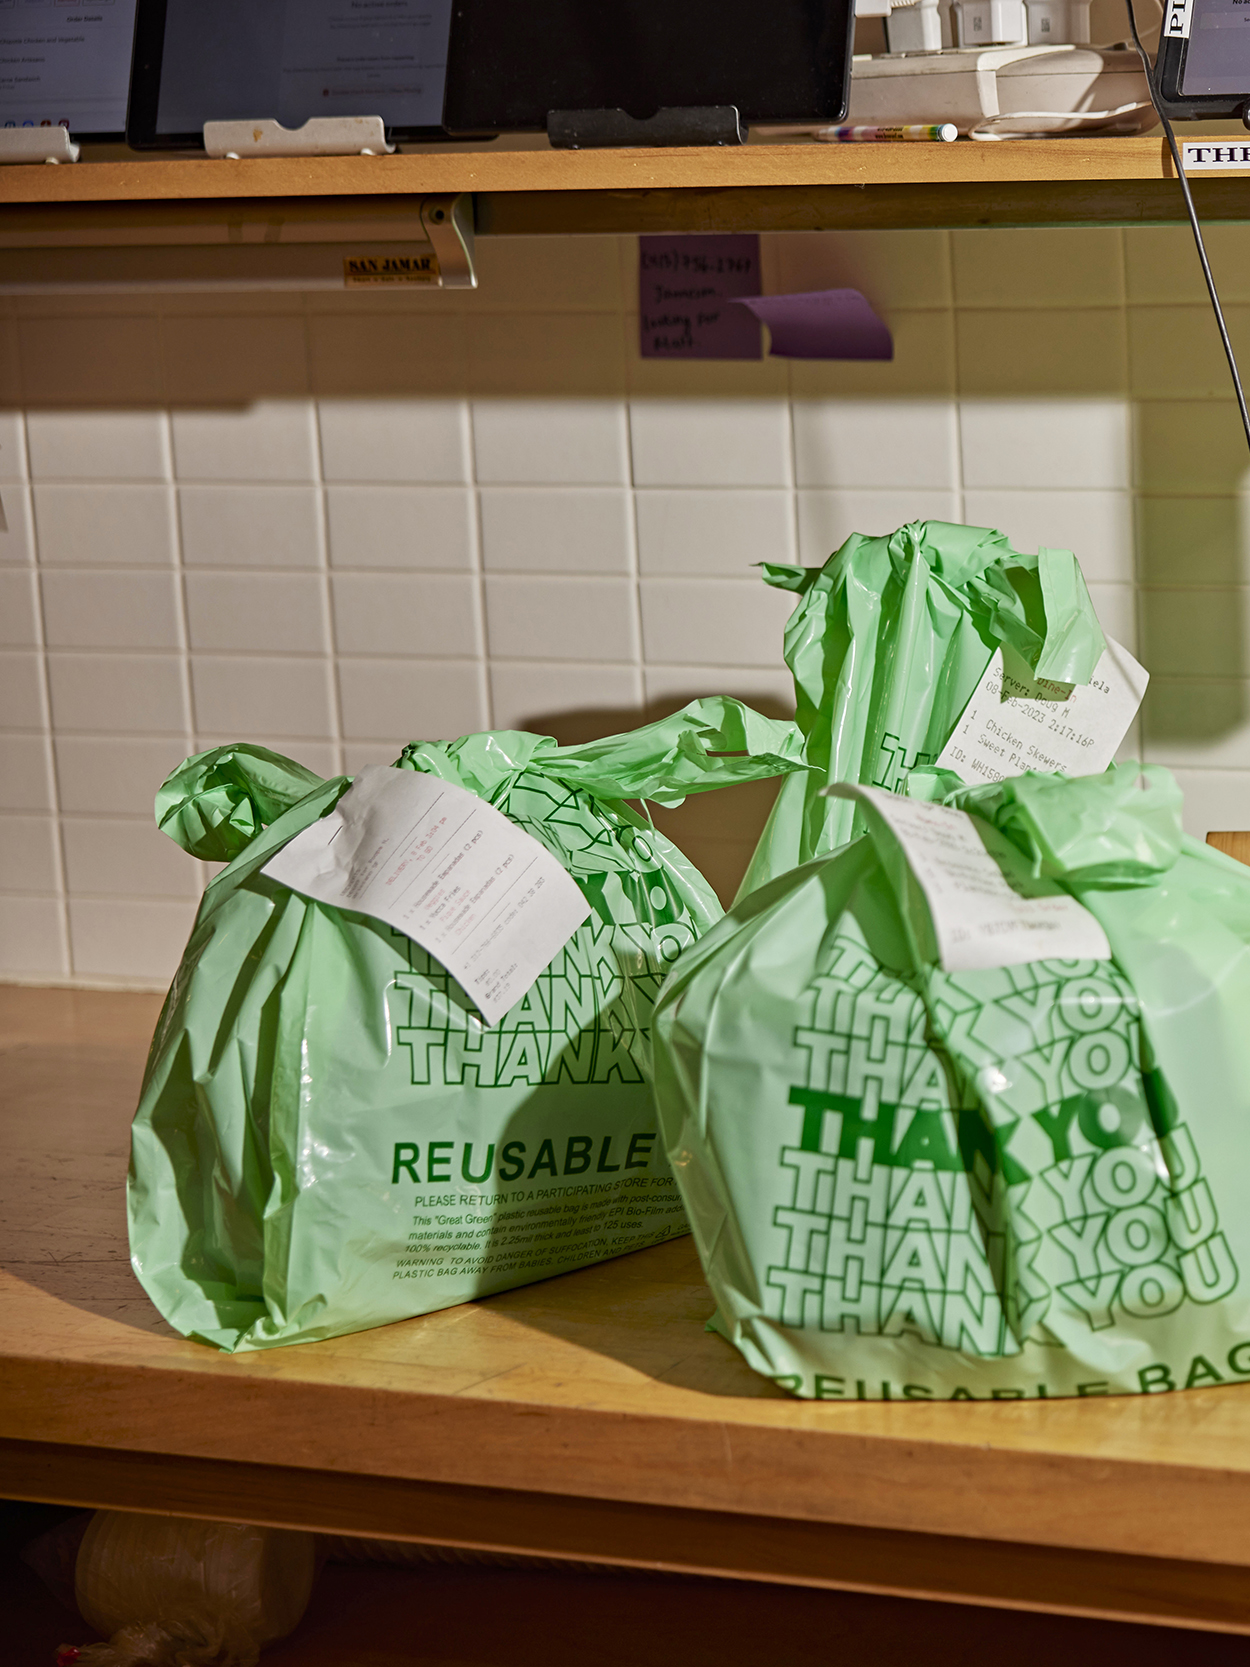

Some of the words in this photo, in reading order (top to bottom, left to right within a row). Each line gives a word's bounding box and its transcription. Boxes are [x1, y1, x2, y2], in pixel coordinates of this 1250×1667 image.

[348, 259, 378, 273] SAN
[382, 257, 431, 272] JAMAR
[991, 668, 1031, 695] Server:
[1034, 692, 1059, 712] Doug
[1061, 707, 1070, 718] M
[983, 681, 1047, 722] 08-Feb-2023
[1048, 719, 1094, 749] 2:17:16P
[949, 747, 967, 762] ID:
[962, 725, 970, 734] 1
[977, 734, 1006, 756] Sweet
[970, 710, 977, 719] 1
[983, 719, 1025, 749] Chicken
[1026, 745, 1068, 773] Skewers
[415, 838, 427, 850] Feb
[413, 879, 440, 908] Housemade
[438, 850, 464, 880] Empanadas
[470, 829, 484, 844] pcs)
[429, 901, 446, 919] Yucca
[444, 884, 461, 902] Fries
[445, 903, 471, 932] Housemade
[470, 874, 496, 904] Empanadas
[501, 853, 515, 867] pcs)
[397, 1026, 646, 1088] THANK
[391, 1132, 657, 1184] REUSABLE
[415, 1195, 456, 1207] PLEASE
[460, 1194, 508, 1205] RETURN
[511, 1192, 524, 1202] TO
[527, 1191, 534, 1200] A
[536, 1183, 613, 1199] PARTICIPATING
[613, 1178, 648, 1190] STORE
[650, 1177, 673, 1186] FOR
[409, 1230, 452, 1240] materials
[456, 1229, 473, 1239] and
[476, 1226, 506, 1238] contain
[509, 1216, 577, 1233] environmentally
[579, 1212, 606, 1223] friendly
[609, 1208, 623, 1216] EPI
[627, 1206, 663, 1215] Bio-Film
[413, 1216, 431, 1226] This
[435, 1215, 462, 1225] "Great
[465, 1213, 497, 1224] Green"
[498, 1209, 525, 1222] plastic
[526, 1205, 561, 1218] reusable
[564, 1204, 579, 1214] bag
[582, 1203, 589, 1211] is
[590, 1199, 611, 1209] made
[612, 1195, 628, 1203] with
[405, 1245, 431, 1253] 100%
[433, 1242, 481, 1254] recyclable.
[501, 1236, 533, 1246] 2.25mil
[534, 1231, 554, 1242] thick
[555, 1229, 571, 1238] and
[573, 1226, 592, 1236] least
[593, 1224, 601, 1232] to
[621, 1220, 643, 1228] uses.
[1047, 1177, 1219, 1281] YOU
[393, 1268, 435, 1279] PLASTIC
[437, 1267, 458, 1276] BAG
[490, 1263, 517, 1273] FROM
[557, 1251, 600, 1264] CHILDREN
[603, 1248, 621, 1256] AND
[397, 1258, 444, 1267] WARNING
[464, 1255, 494, 1264] AVOID
[496, 1250, 533, 1262] DANGER
[535, 1249, 546, 1257] OF
[612, 1237, 635, 1245] KEEP
[1055, 1231, 1240, 1333] YOU
